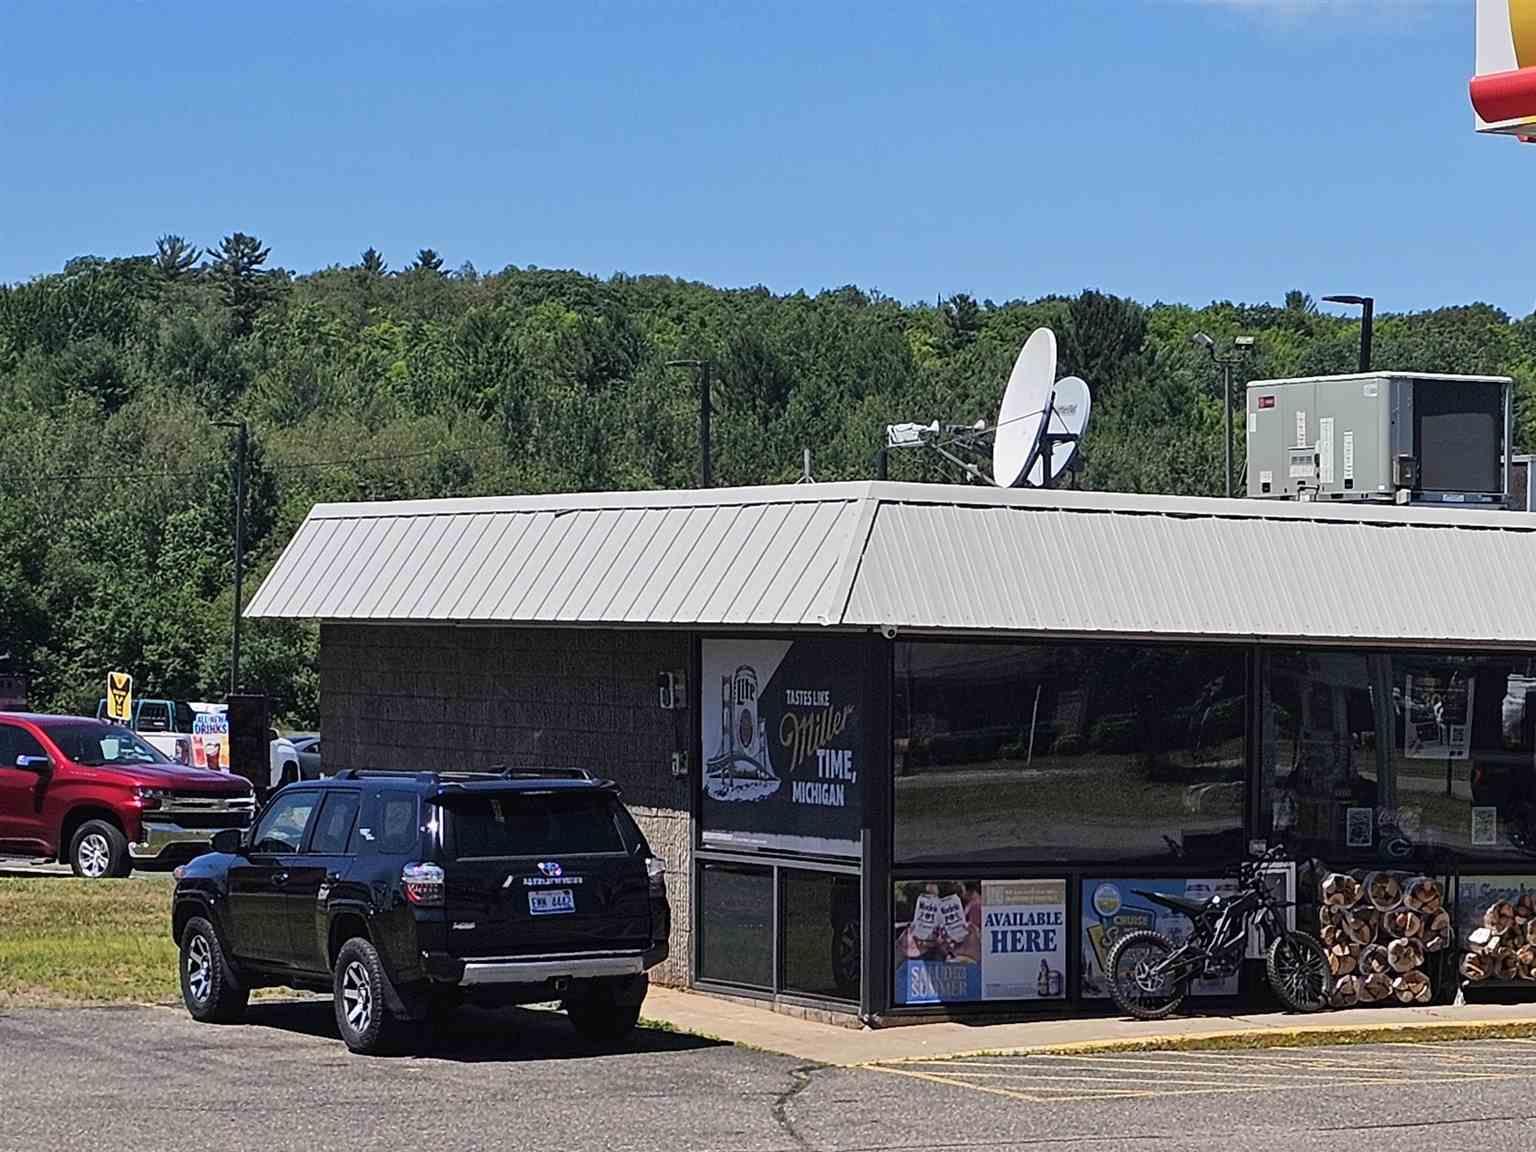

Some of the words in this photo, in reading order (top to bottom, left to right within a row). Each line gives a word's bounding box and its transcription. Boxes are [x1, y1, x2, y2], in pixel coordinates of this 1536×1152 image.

[786, 690, 811, 706] TASTES
[813, 690, 830, 706] LIKE
[779, 703, 856, 773] Miller
[817, 749, 857, 784] TIME,
[792, 781, 845, 806] MICHIGAN
[984, 911, 1064, 928] AVAILABLE
[990, 928, 1058, 954] HERE
